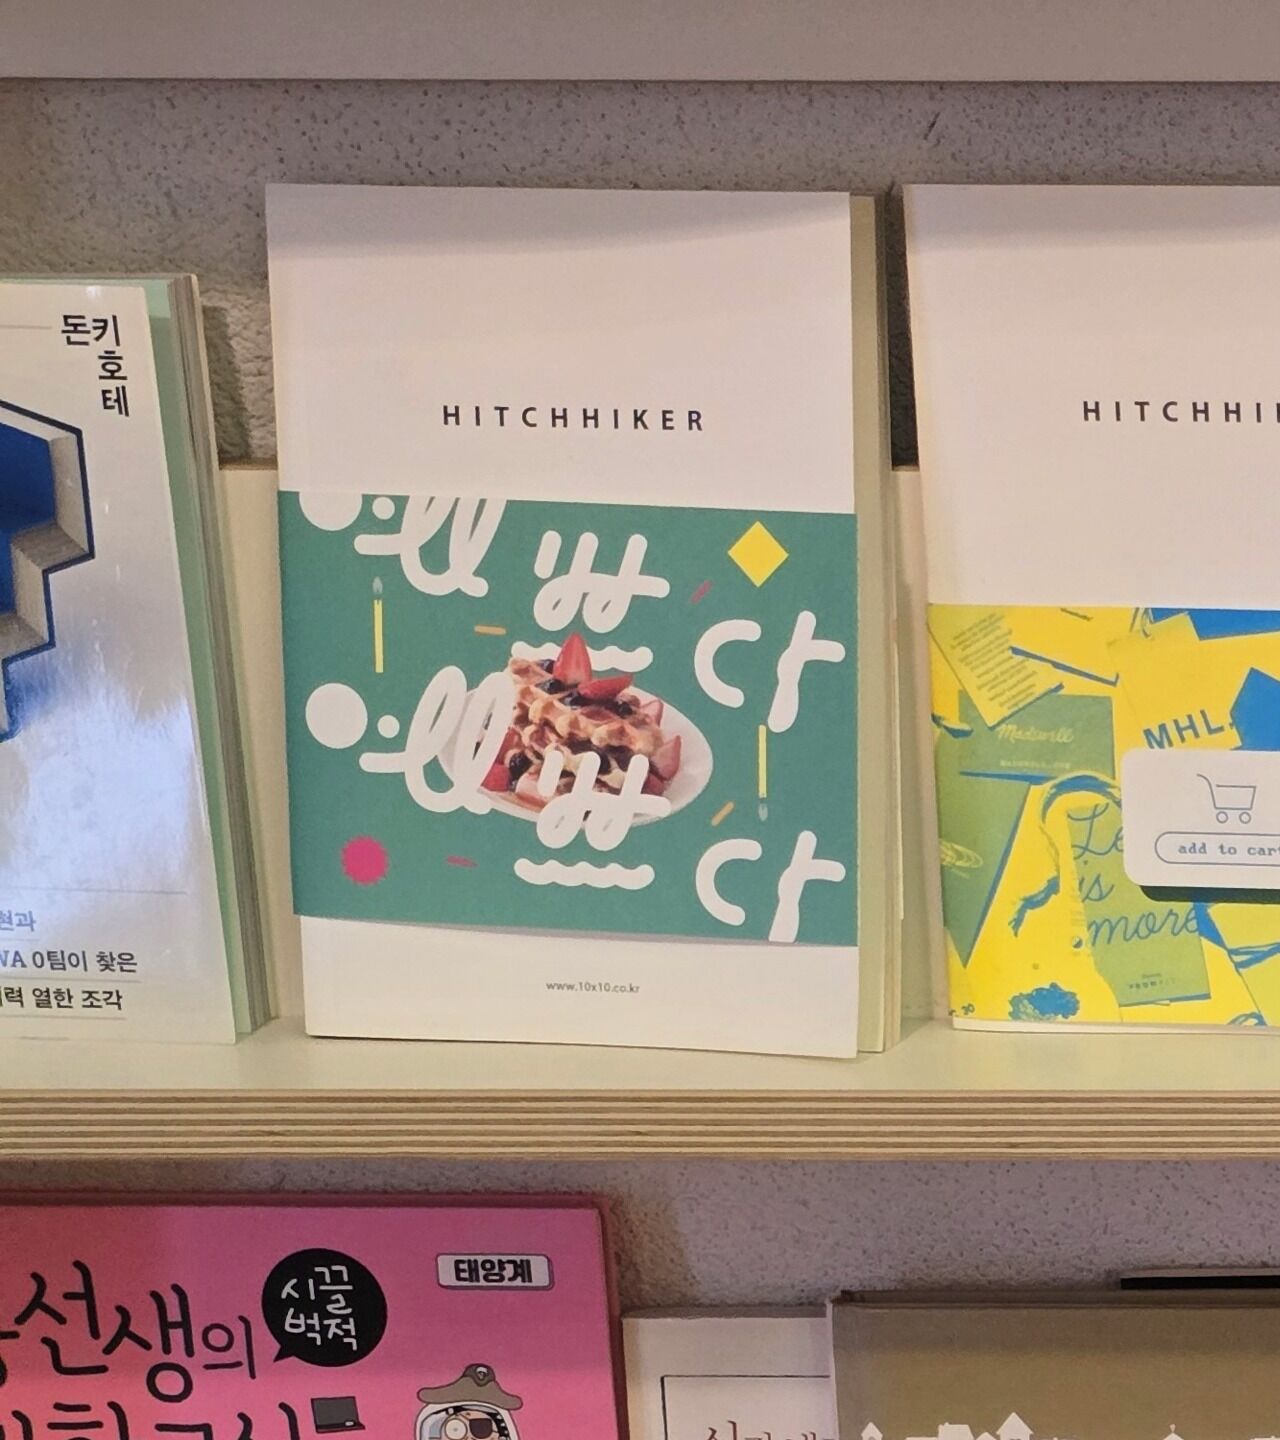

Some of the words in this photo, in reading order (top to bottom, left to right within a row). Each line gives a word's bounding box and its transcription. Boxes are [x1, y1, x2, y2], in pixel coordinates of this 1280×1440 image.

[443, 404, 704, 432] HITCHHIKER
[1178, 841, 1208, 857] add
[1219, 842, 1239, 857] to
[1087, 907, 1200, 948] more
[95, 950, 138, 974] 찾은
[32, 986, 74, 1009] 열한
[81, 989, 123, 1011] 조각
[545, 980, 641, 996] www.10x10.co.kr
[453, 1258, 534, 1286] 태양계
[280, 1263, 355, 1315] 시끌
[283, 1309, 359, 1352] 벅적
